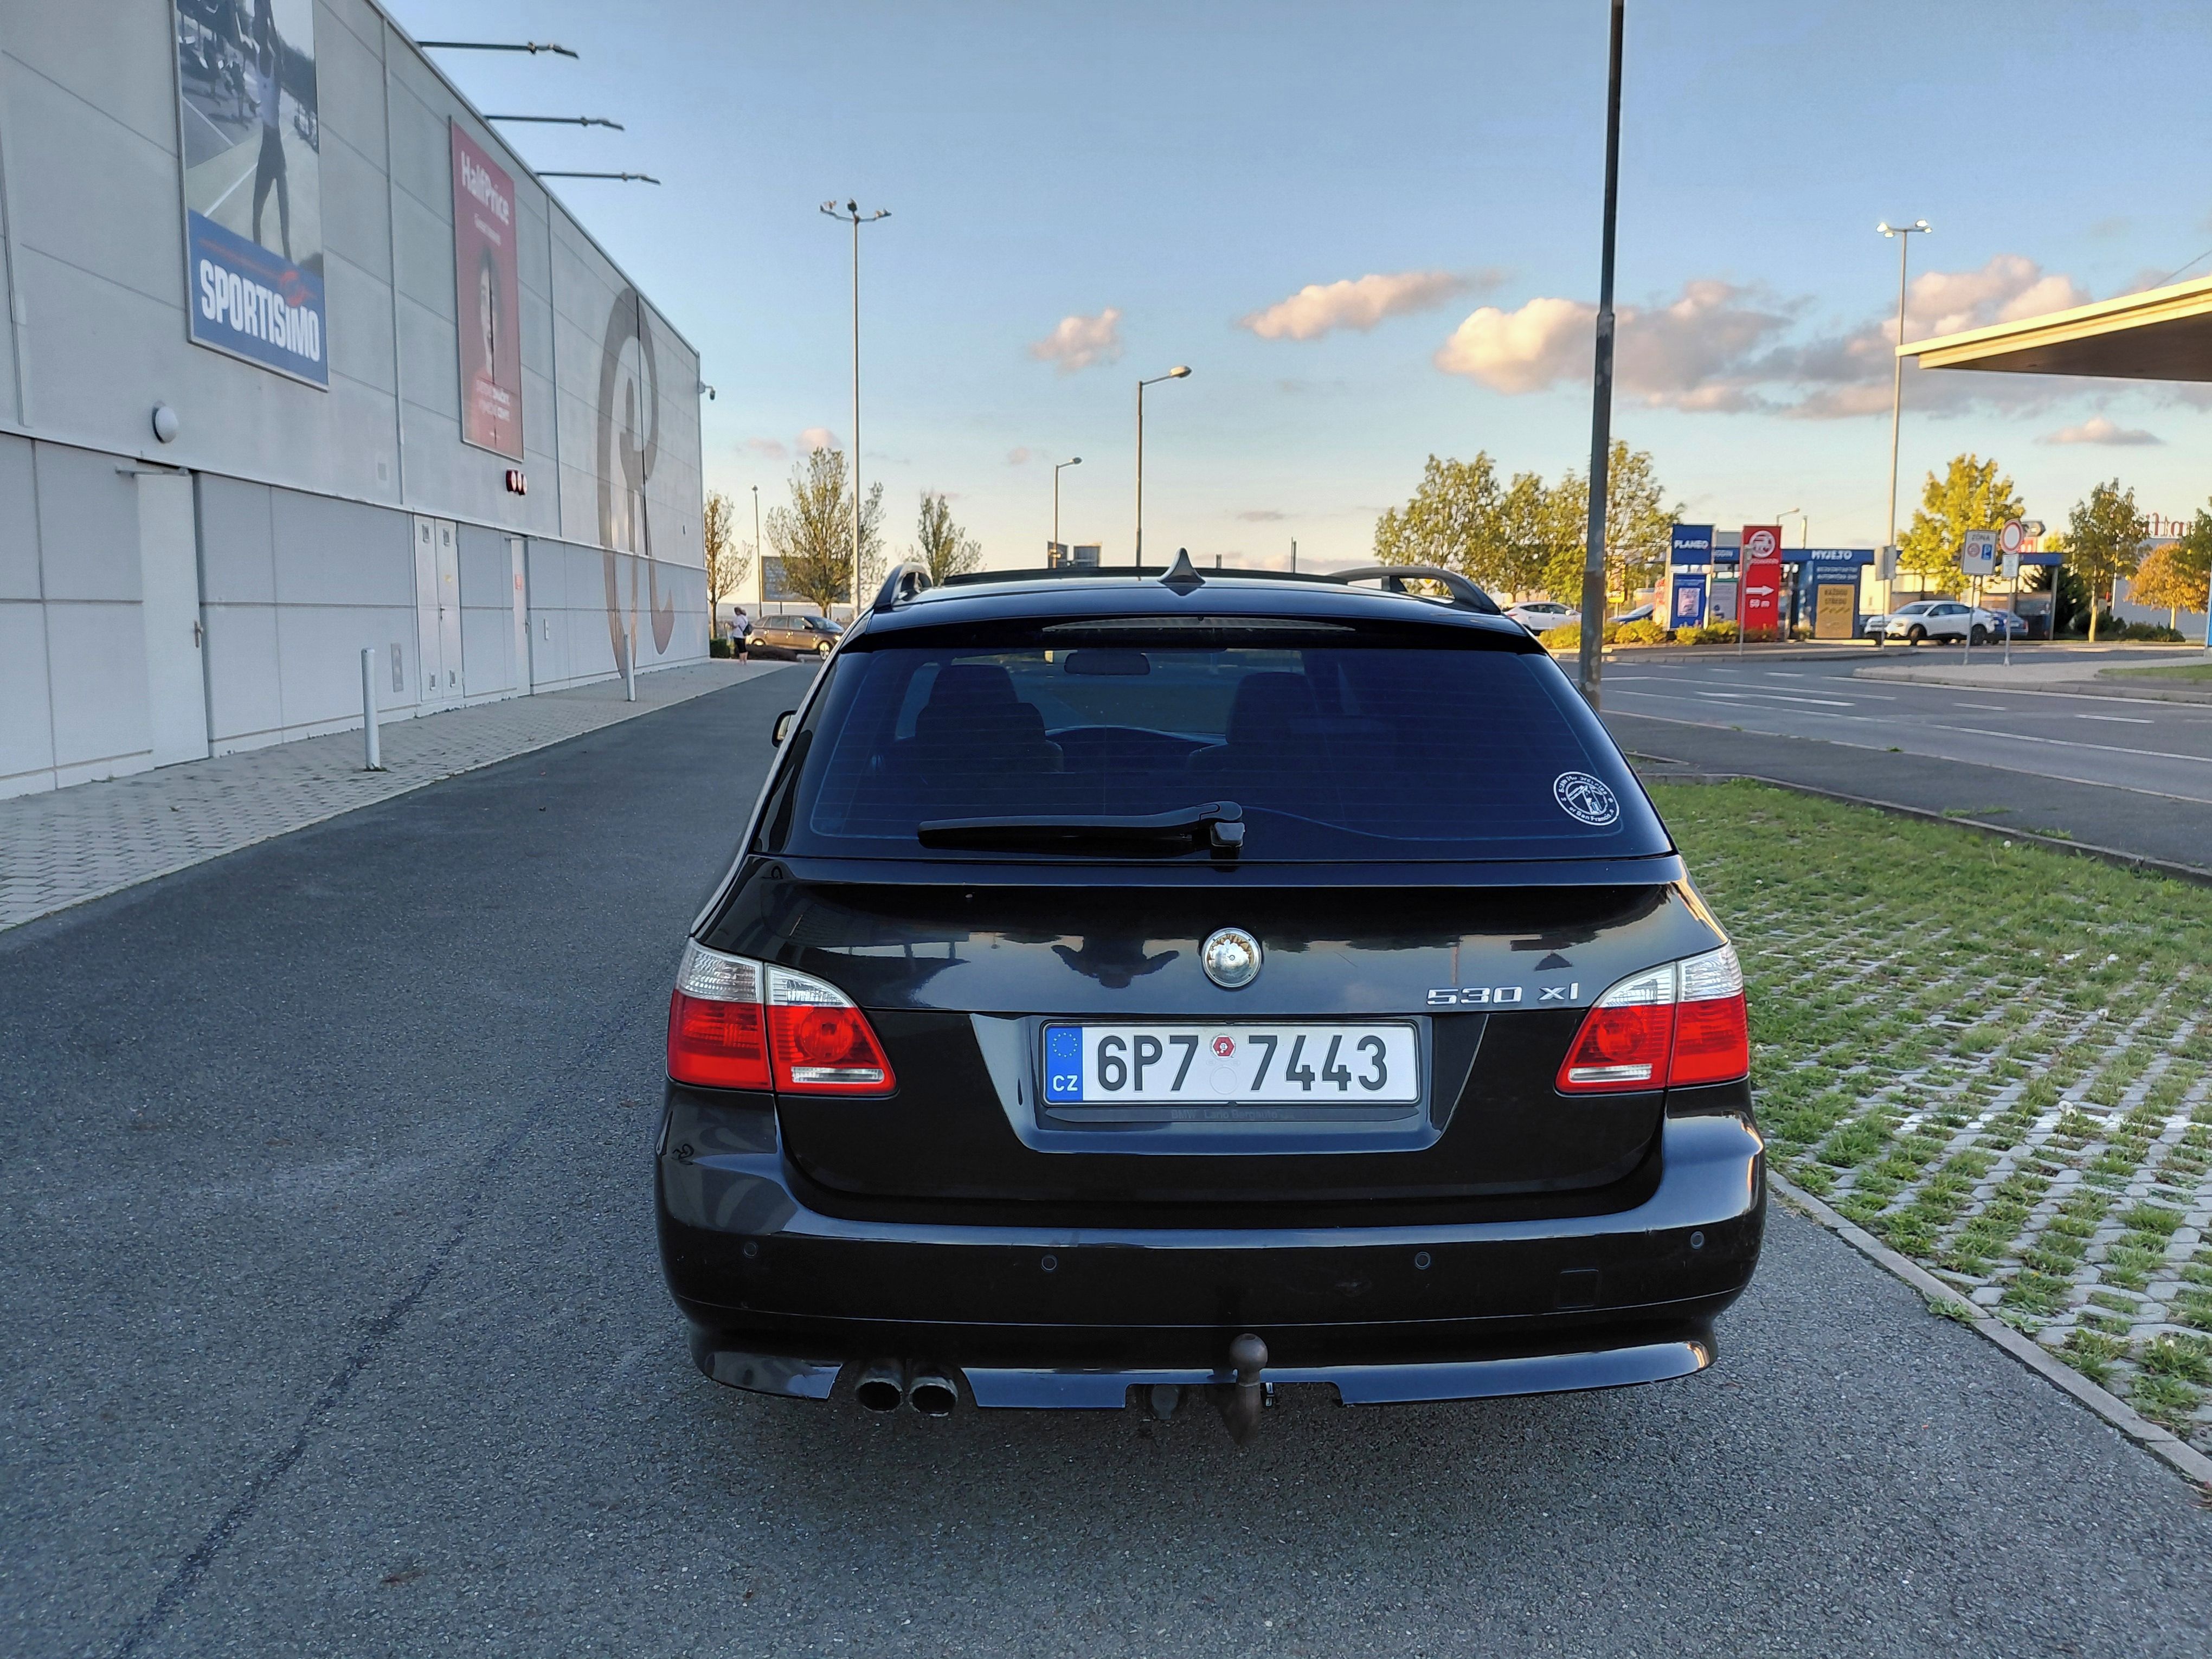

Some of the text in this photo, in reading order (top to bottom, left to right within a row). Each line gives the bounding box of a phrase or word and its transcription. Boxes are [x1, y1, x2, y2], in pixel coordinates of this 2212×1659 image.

[200, 259, 320, 362] SPORTISIMO
[1427, 987, 1520, 1005] 530
[1097, 1034, 1387, 1091] 6P7 7443
[1052, 1075, 1078, 1092] CZ
[1171, 1109, 1196, 1119] BMW
